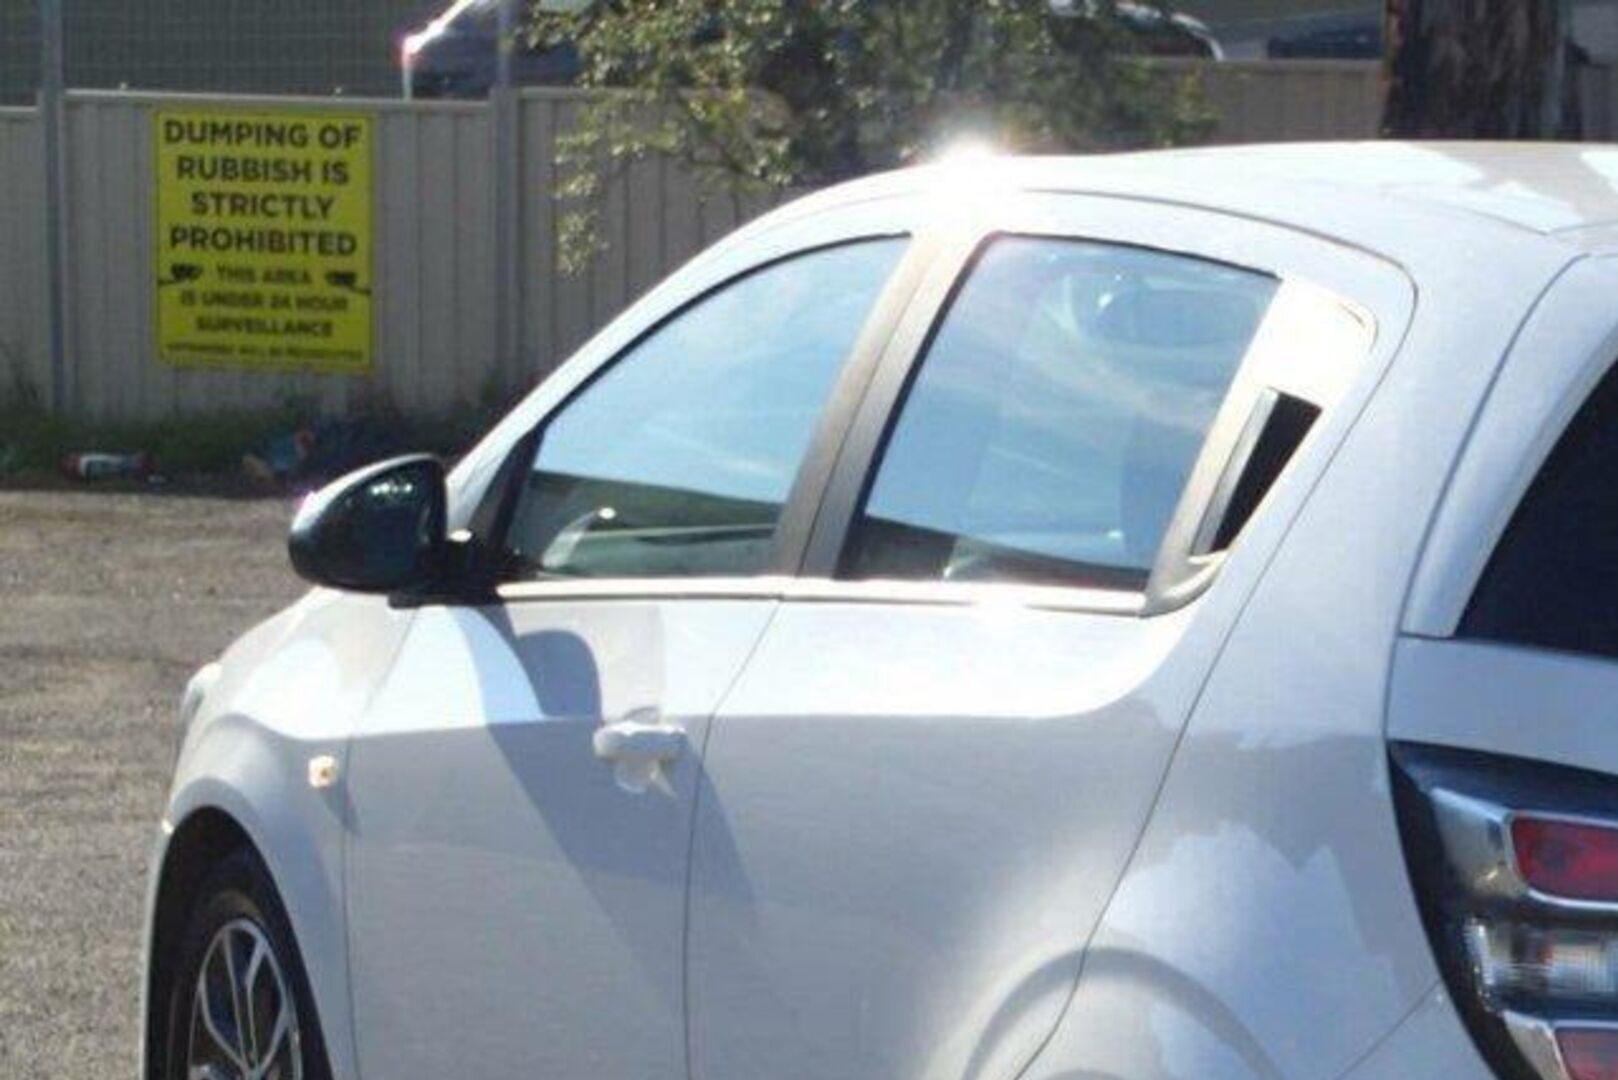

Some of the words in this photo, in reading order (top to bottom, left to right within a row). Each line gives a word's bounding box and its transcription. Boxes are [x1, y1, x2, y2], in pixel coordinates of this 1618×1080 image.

[165, 120, 309, 148] DUMPING
[318, 125, 361, 148] OF
[177, 155, 311, 183] RUBBISH
[322, 162, 349, 185] IS
[191, 191, 335, 219] STRICTLY
[169, 226, 357, 256] PROHIBITED
[217, 264, 256, 284] THIS
[196, 316, 334, 338] SURVEILLANCE
